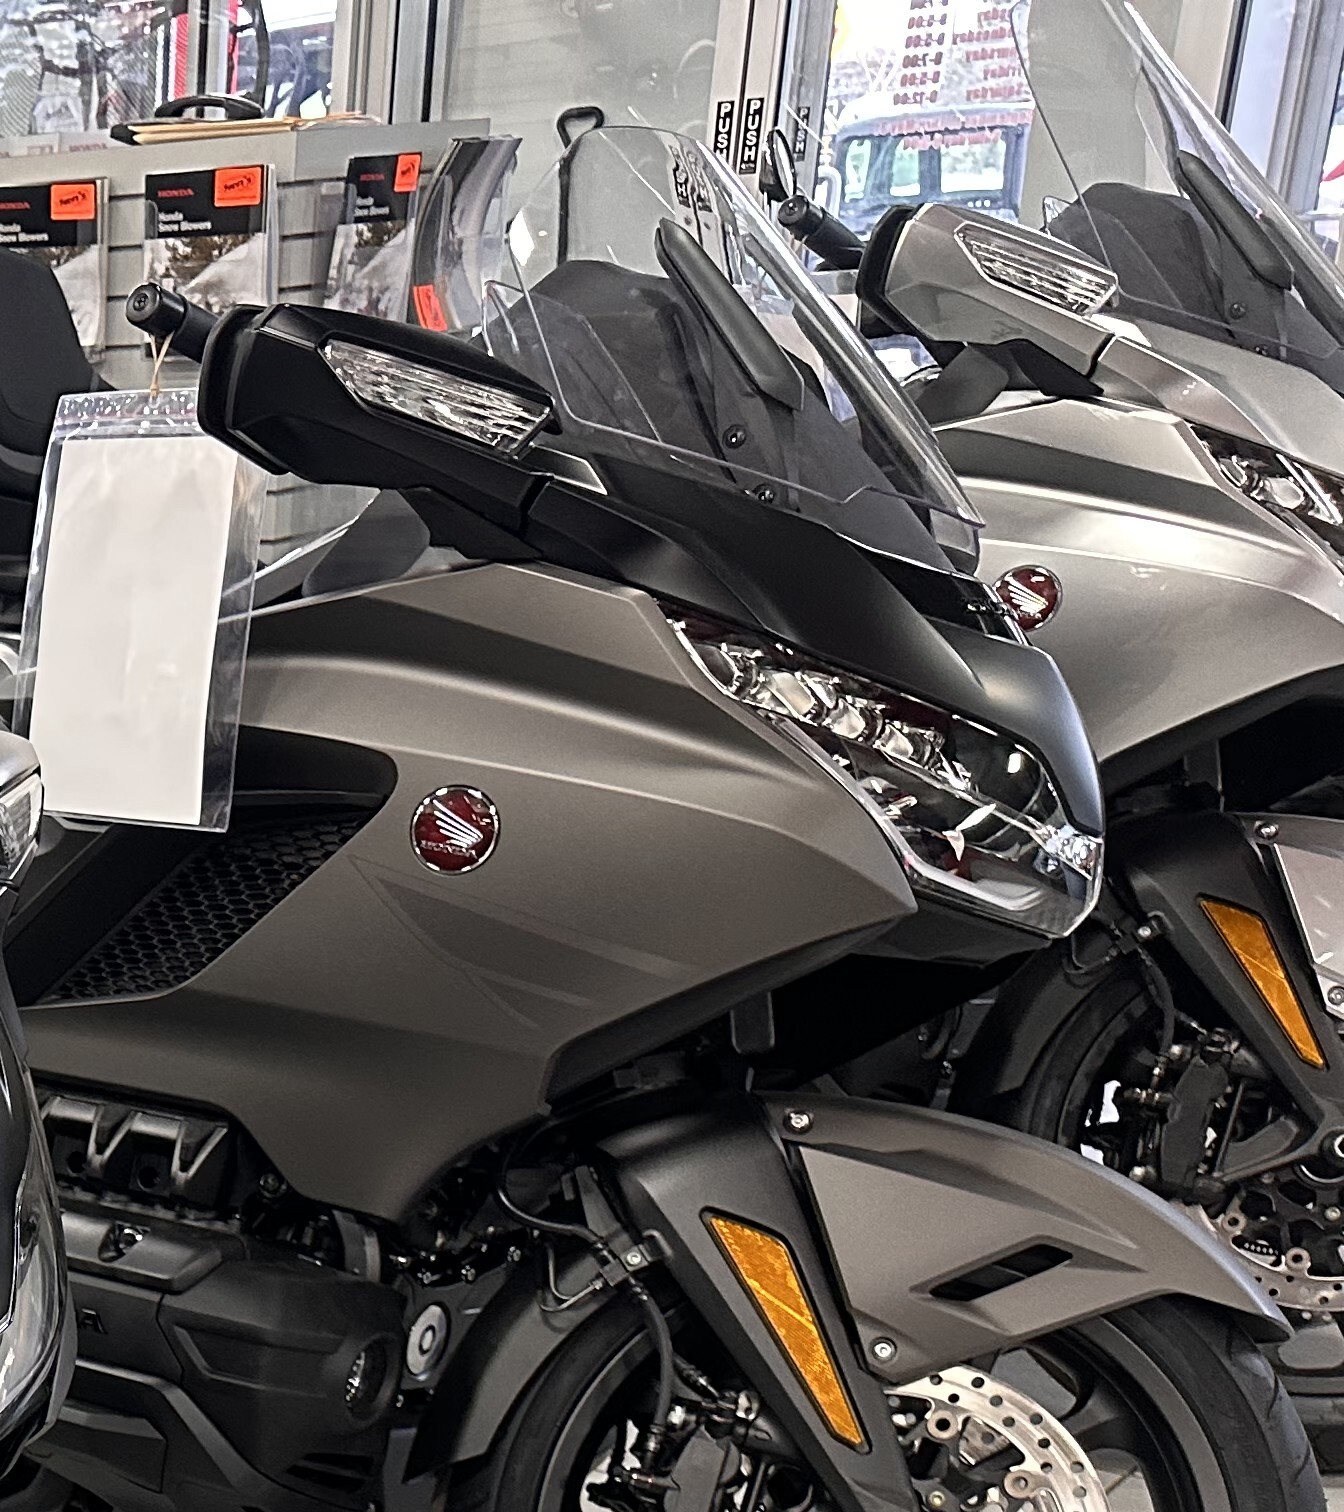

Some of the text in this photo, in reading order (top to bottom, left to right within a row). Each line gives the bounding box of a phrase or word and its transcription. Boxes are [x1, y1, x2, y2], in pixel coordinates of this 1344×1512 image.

[743, 99, 762, 162] PUSH
[157, 188, 194, 198] HONDA
[180, 221, 212, 232] Blowers
[18, 231, 50, 242] Blowers
[419, 839, 479, 860] HONDA
